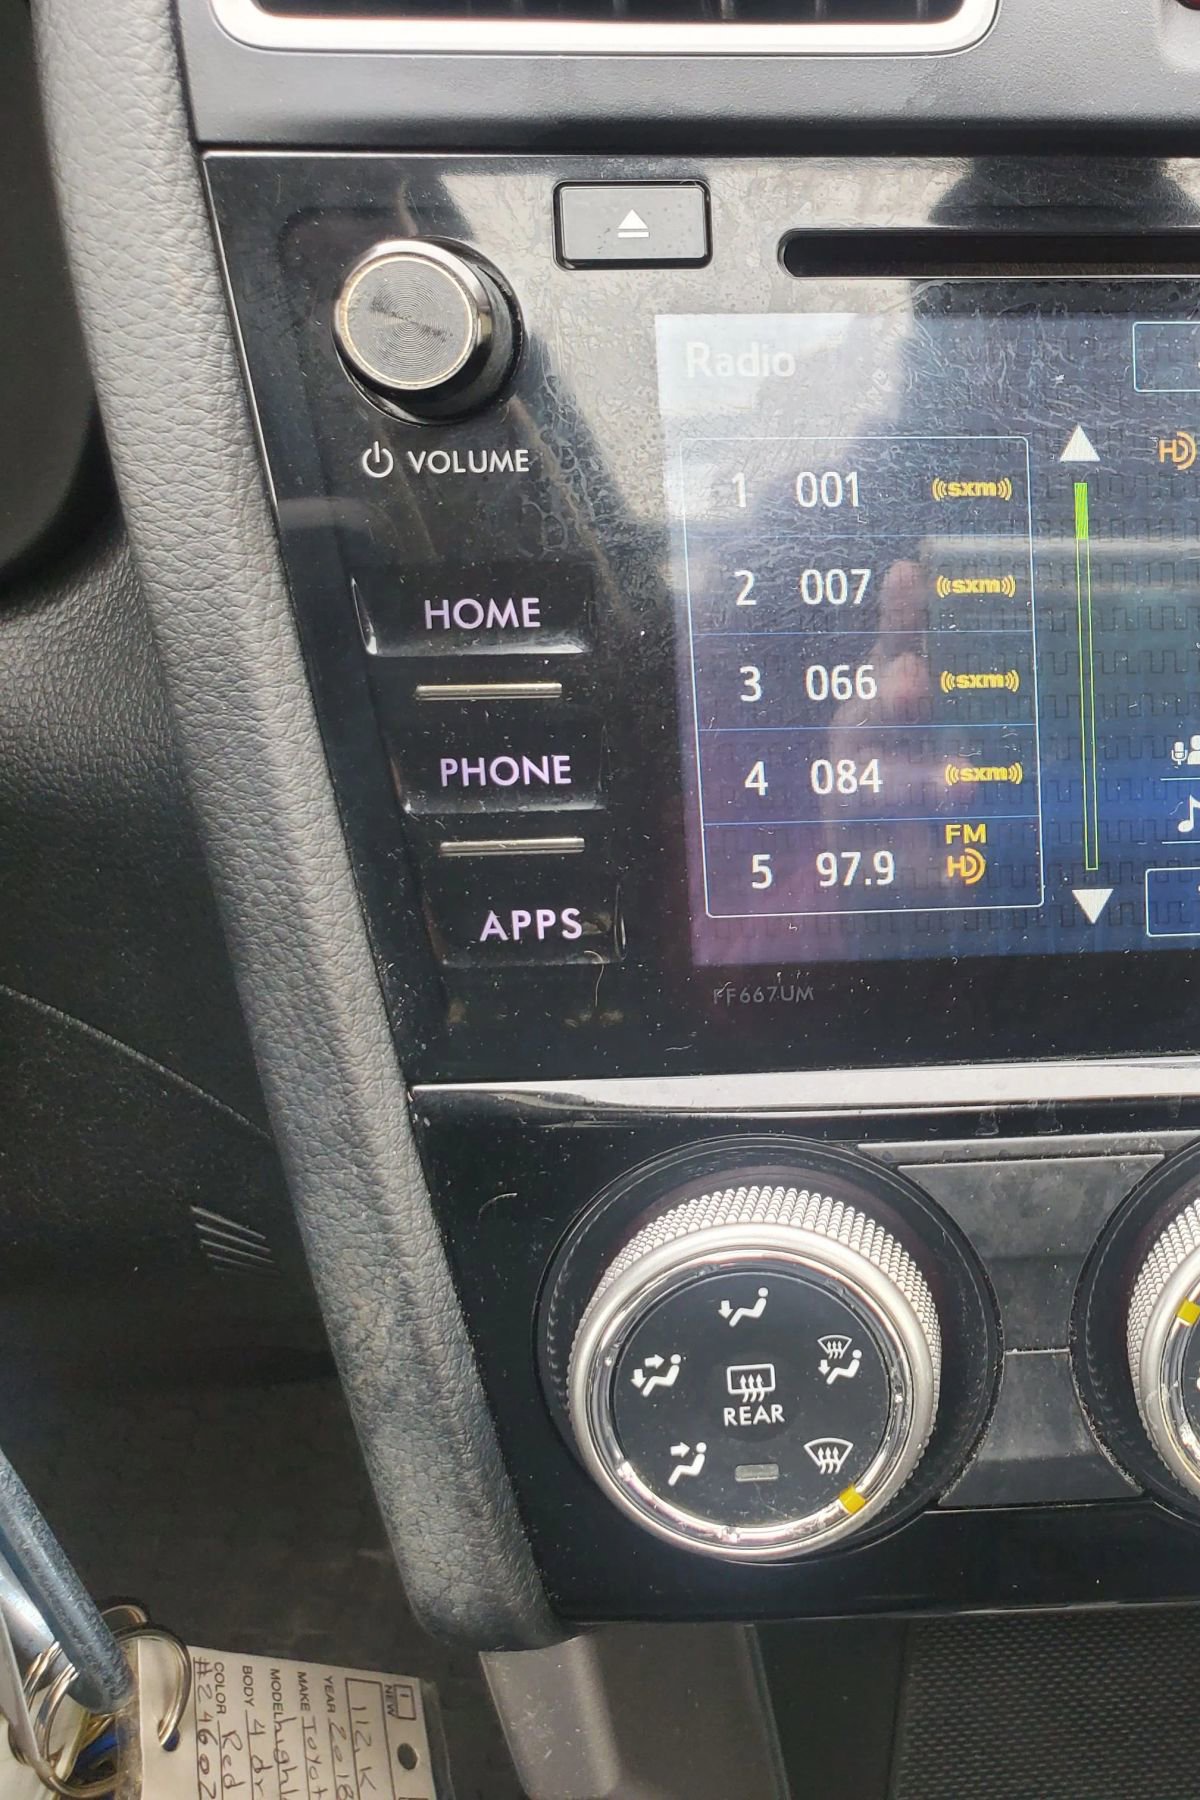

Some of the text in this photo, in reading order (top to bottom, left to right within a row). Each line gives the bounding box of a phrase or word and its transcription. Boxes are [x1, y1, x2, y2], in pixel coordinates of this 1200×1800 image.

[685, 340, 797, 379] Radio
[407, 449, 530, 475] VOLUME
[731, 471, 747, 508] 1
[796, 471, 860, 508] 001
[734, 570, 757, 606] 2
[800, 568, 872, 605] 007
[424, 597, 541, 630] HOME
[739, 666, 762, 702] 3
[805, 665, 878, 701] 066
[440, 755, 572, 787] PHONE
[744, 760, 769, 796] 4
[810, 758, 884, 795] 084
[751, 824, 987, 890] 5 97.9 FM
[479, 907, 583, 942] APPS
[723, 1403, 786, 1427] REAR
[242, 1665, 255, 1707] BODY
[250, 1718, 265, 1736] 4
[270, 1668, 284, 1721] MODEL
[297, 1671, 311, 1711] MAKE
[323, 1676, 336, 1713] YEAR
[385, 1684, 399, 1717] NEW
[214, 1661, 245, 1791] COLOR Red
